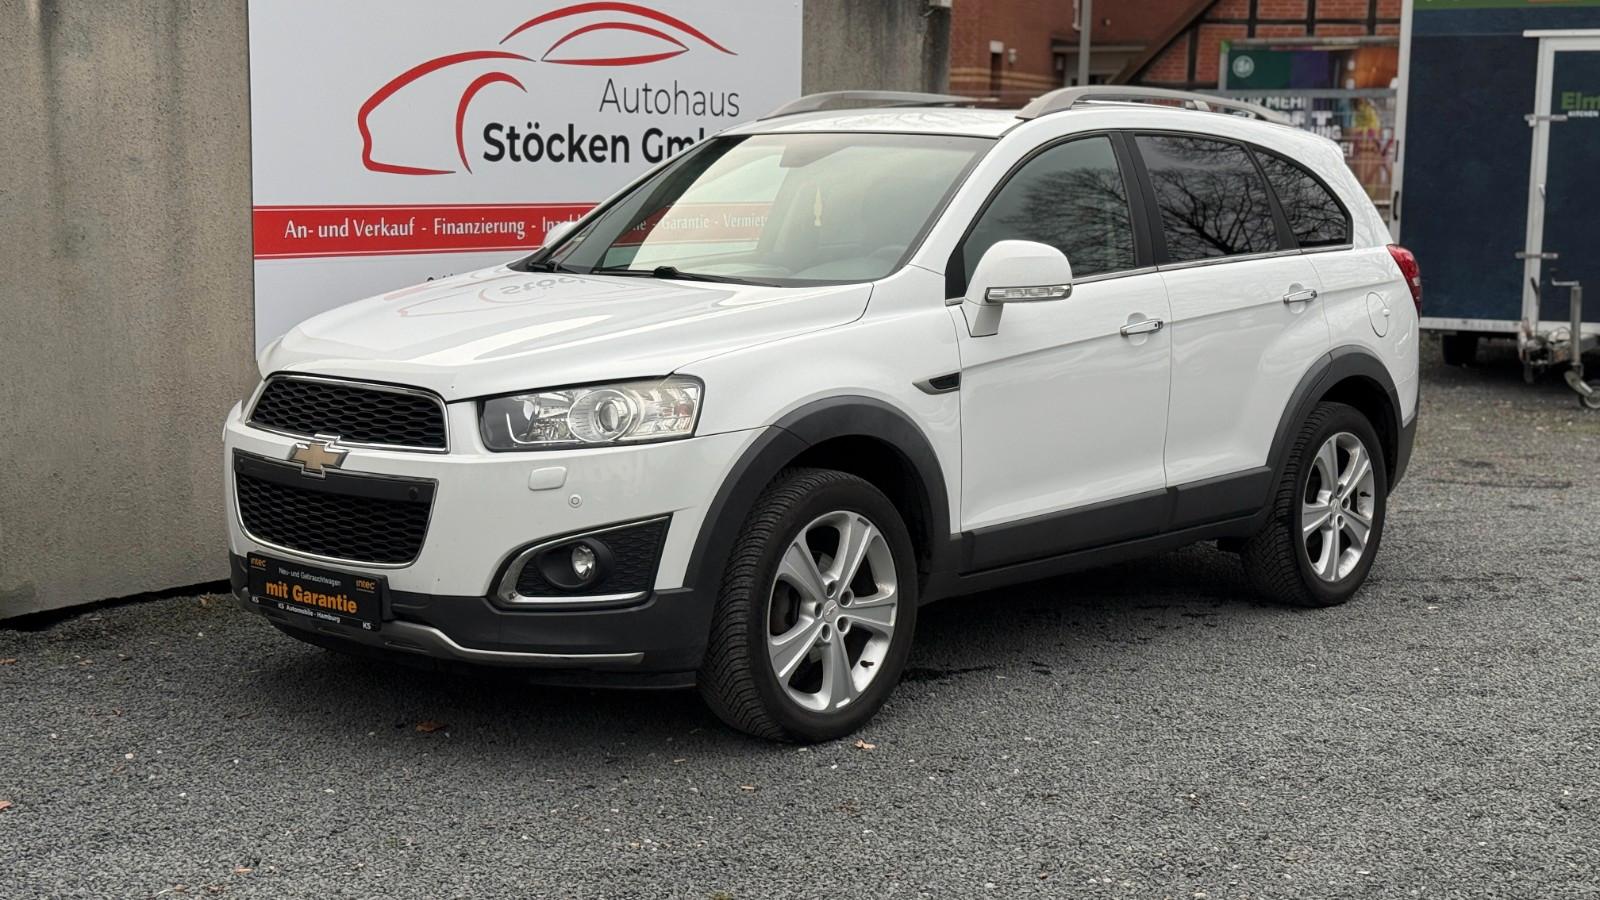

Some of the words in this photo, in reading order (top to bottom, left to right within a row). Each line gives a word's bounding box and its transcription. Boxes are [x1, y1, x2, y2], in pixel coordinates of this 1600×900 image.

[599, 78, 740, 117] Autohaus
[483, 122, 630, 163] Stöcken
[284, 219, 314, 239] An-
[318, 217, 349, 238] und
[353, 216, 416, 237] Verkauf
[434, 217, 526, 240] Finanzierung
[265, 580, 289, 599] mit
[292, 584, 358, 614] Garantie
[317, 612, 341, 624] Hamburg
